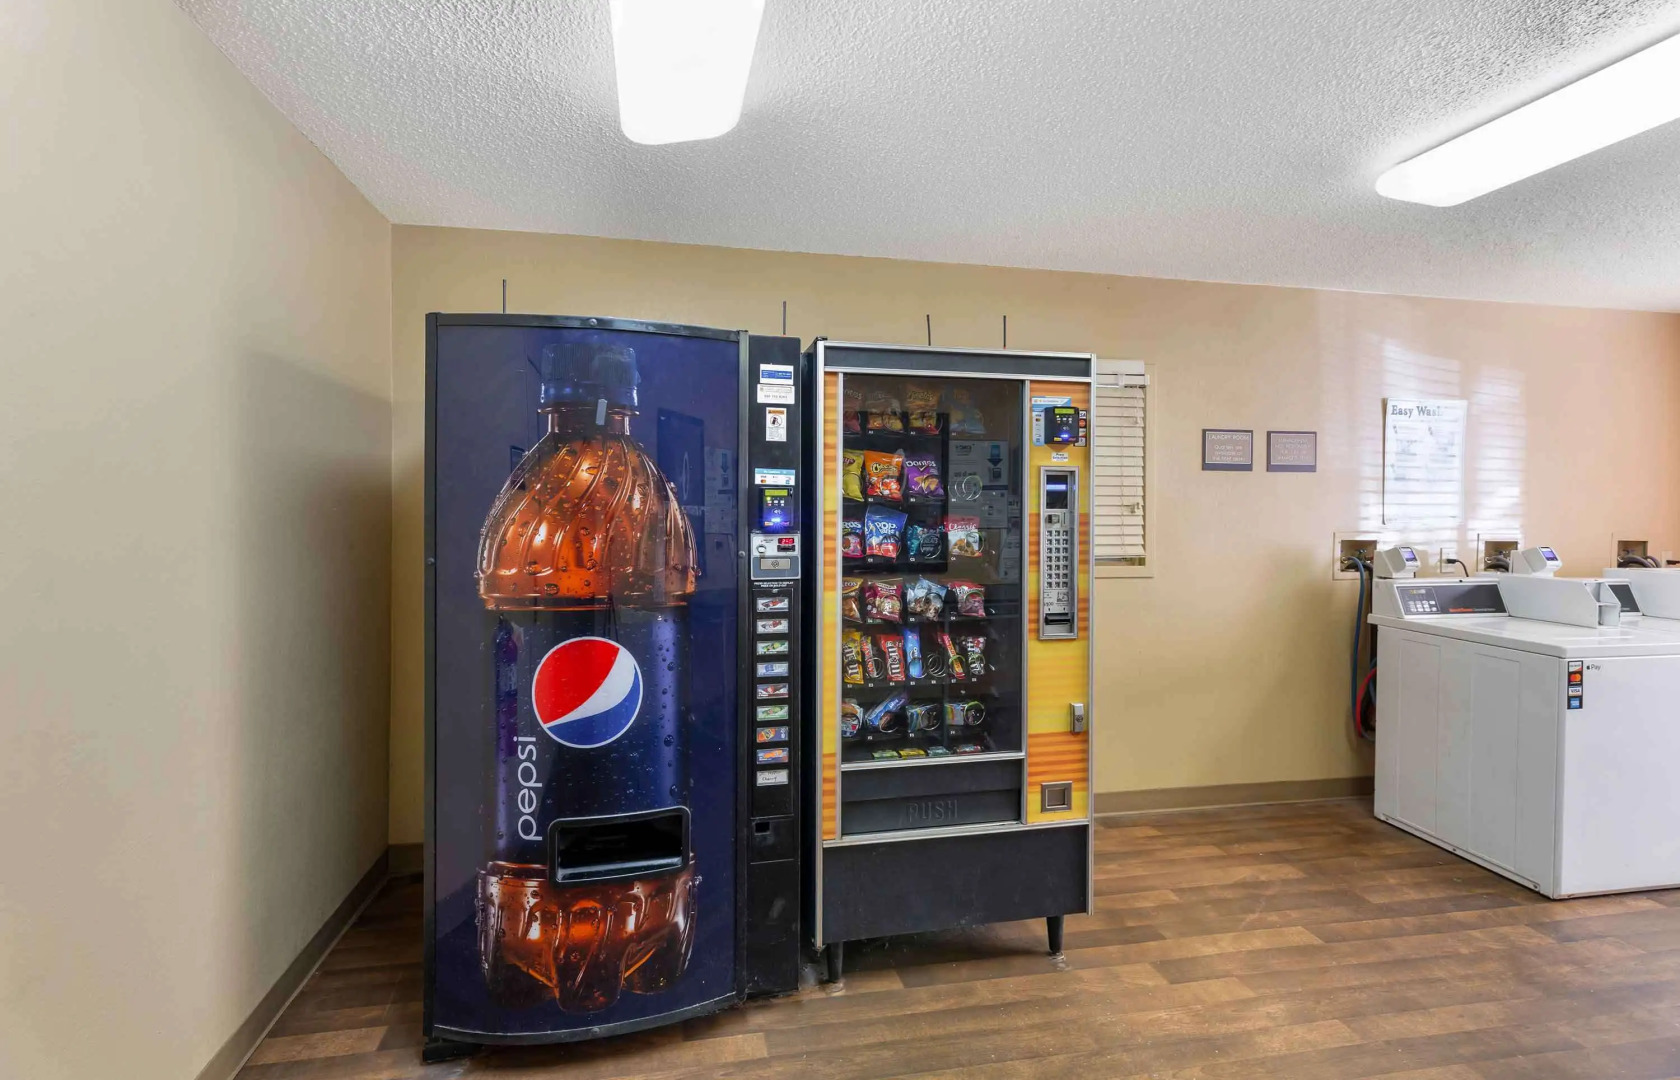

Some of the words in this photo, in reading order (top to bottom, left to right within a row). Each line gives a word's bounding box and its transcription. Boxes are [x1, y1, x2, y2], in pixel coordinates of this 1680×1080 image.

[1391, 405, 1414, 419] Easy
[513, 736, 543, 841] pepsi
[907, 799, 958, 823] PUSH
